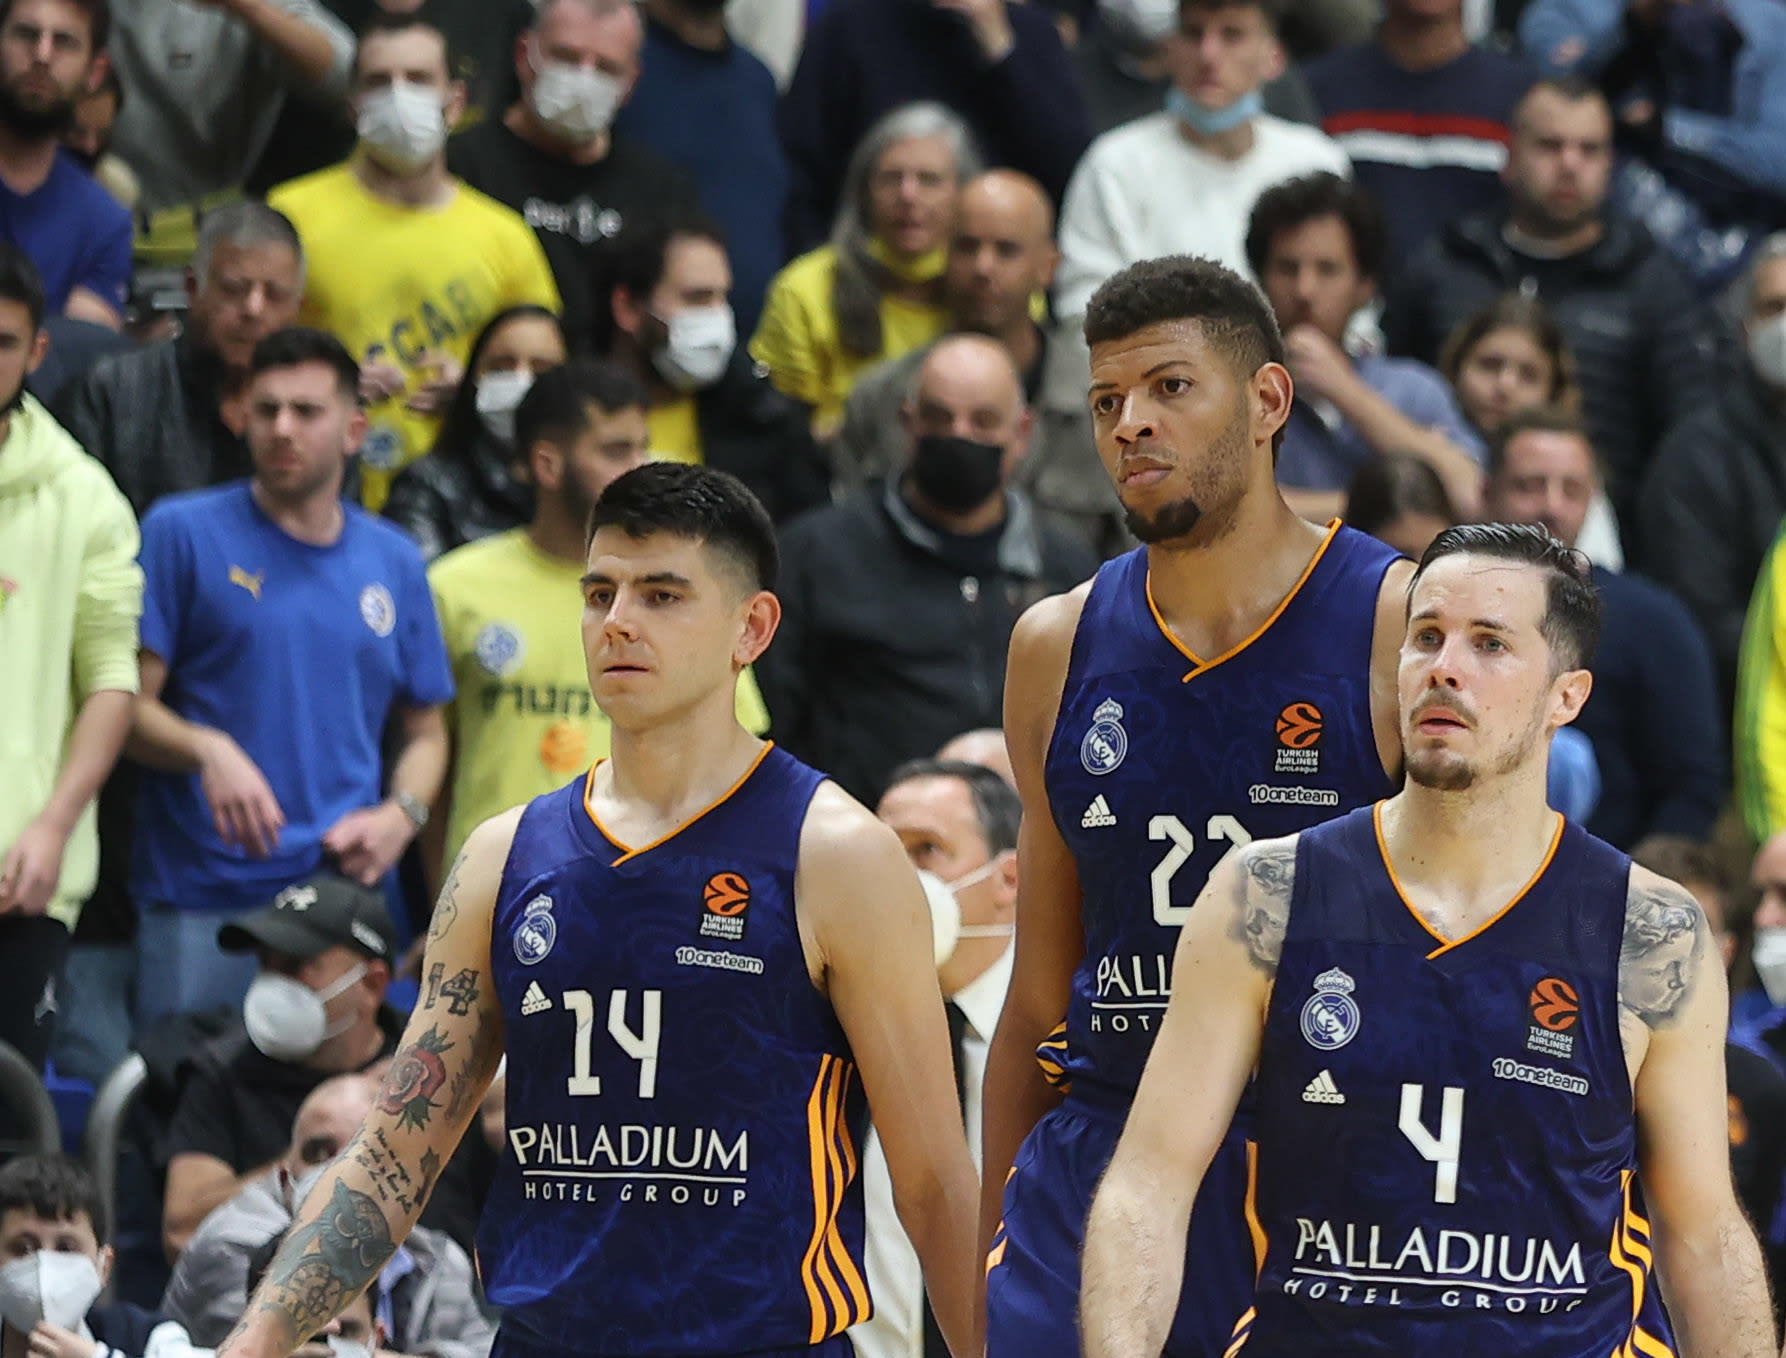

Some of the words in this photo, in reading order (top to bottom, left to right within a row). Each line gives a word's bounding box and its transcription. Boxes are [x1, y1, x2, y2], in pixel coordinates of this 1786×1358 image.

[1275, 757, 1318, 766] AIRLINES
[1276, 749, 1319, 758] TURKISH
[702, 921, 743, 934] AIRLINES
[703, 913, 744, 926] TURKISH
[562, 989, 662, 1099] 14
[1528, 1035, 1572, 1052] AIRLINES
[1529, 1026, 1574, 1044] TURKISH
[509, 1123, 749, 1172] PALLADIUM
[1399, 1083, 1465, 1204] 4
[525, 1182, 597, 1202] HOTEL
[621, 1184, 747, 1207] GROUP
[1294, 1218, 1587, 1285] PALLADIUM
[1283, 1279, 1402, 1305] HOTEL
